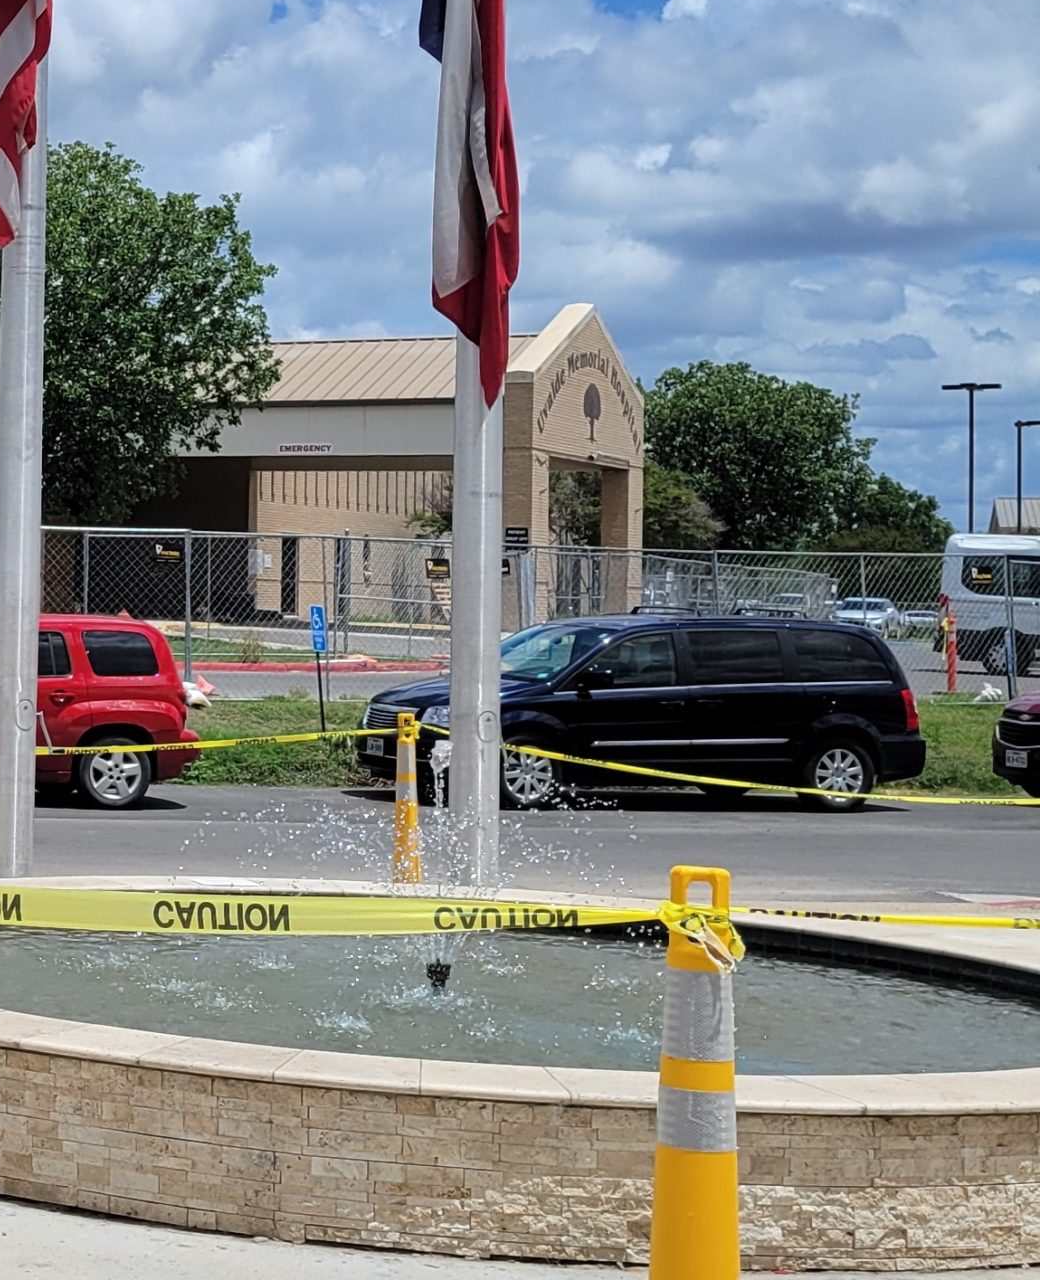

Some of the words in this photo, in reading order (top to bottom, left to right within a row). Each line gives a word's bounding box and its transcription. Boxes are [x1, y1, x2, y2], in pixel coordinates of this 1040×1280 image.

[537, 369, 566, 434] Uvalde
[567, 348, 609, 378] Memorial
[611, 365, 642, 455] Hospital
[279, 444, 332, 453] EMERGENCY
